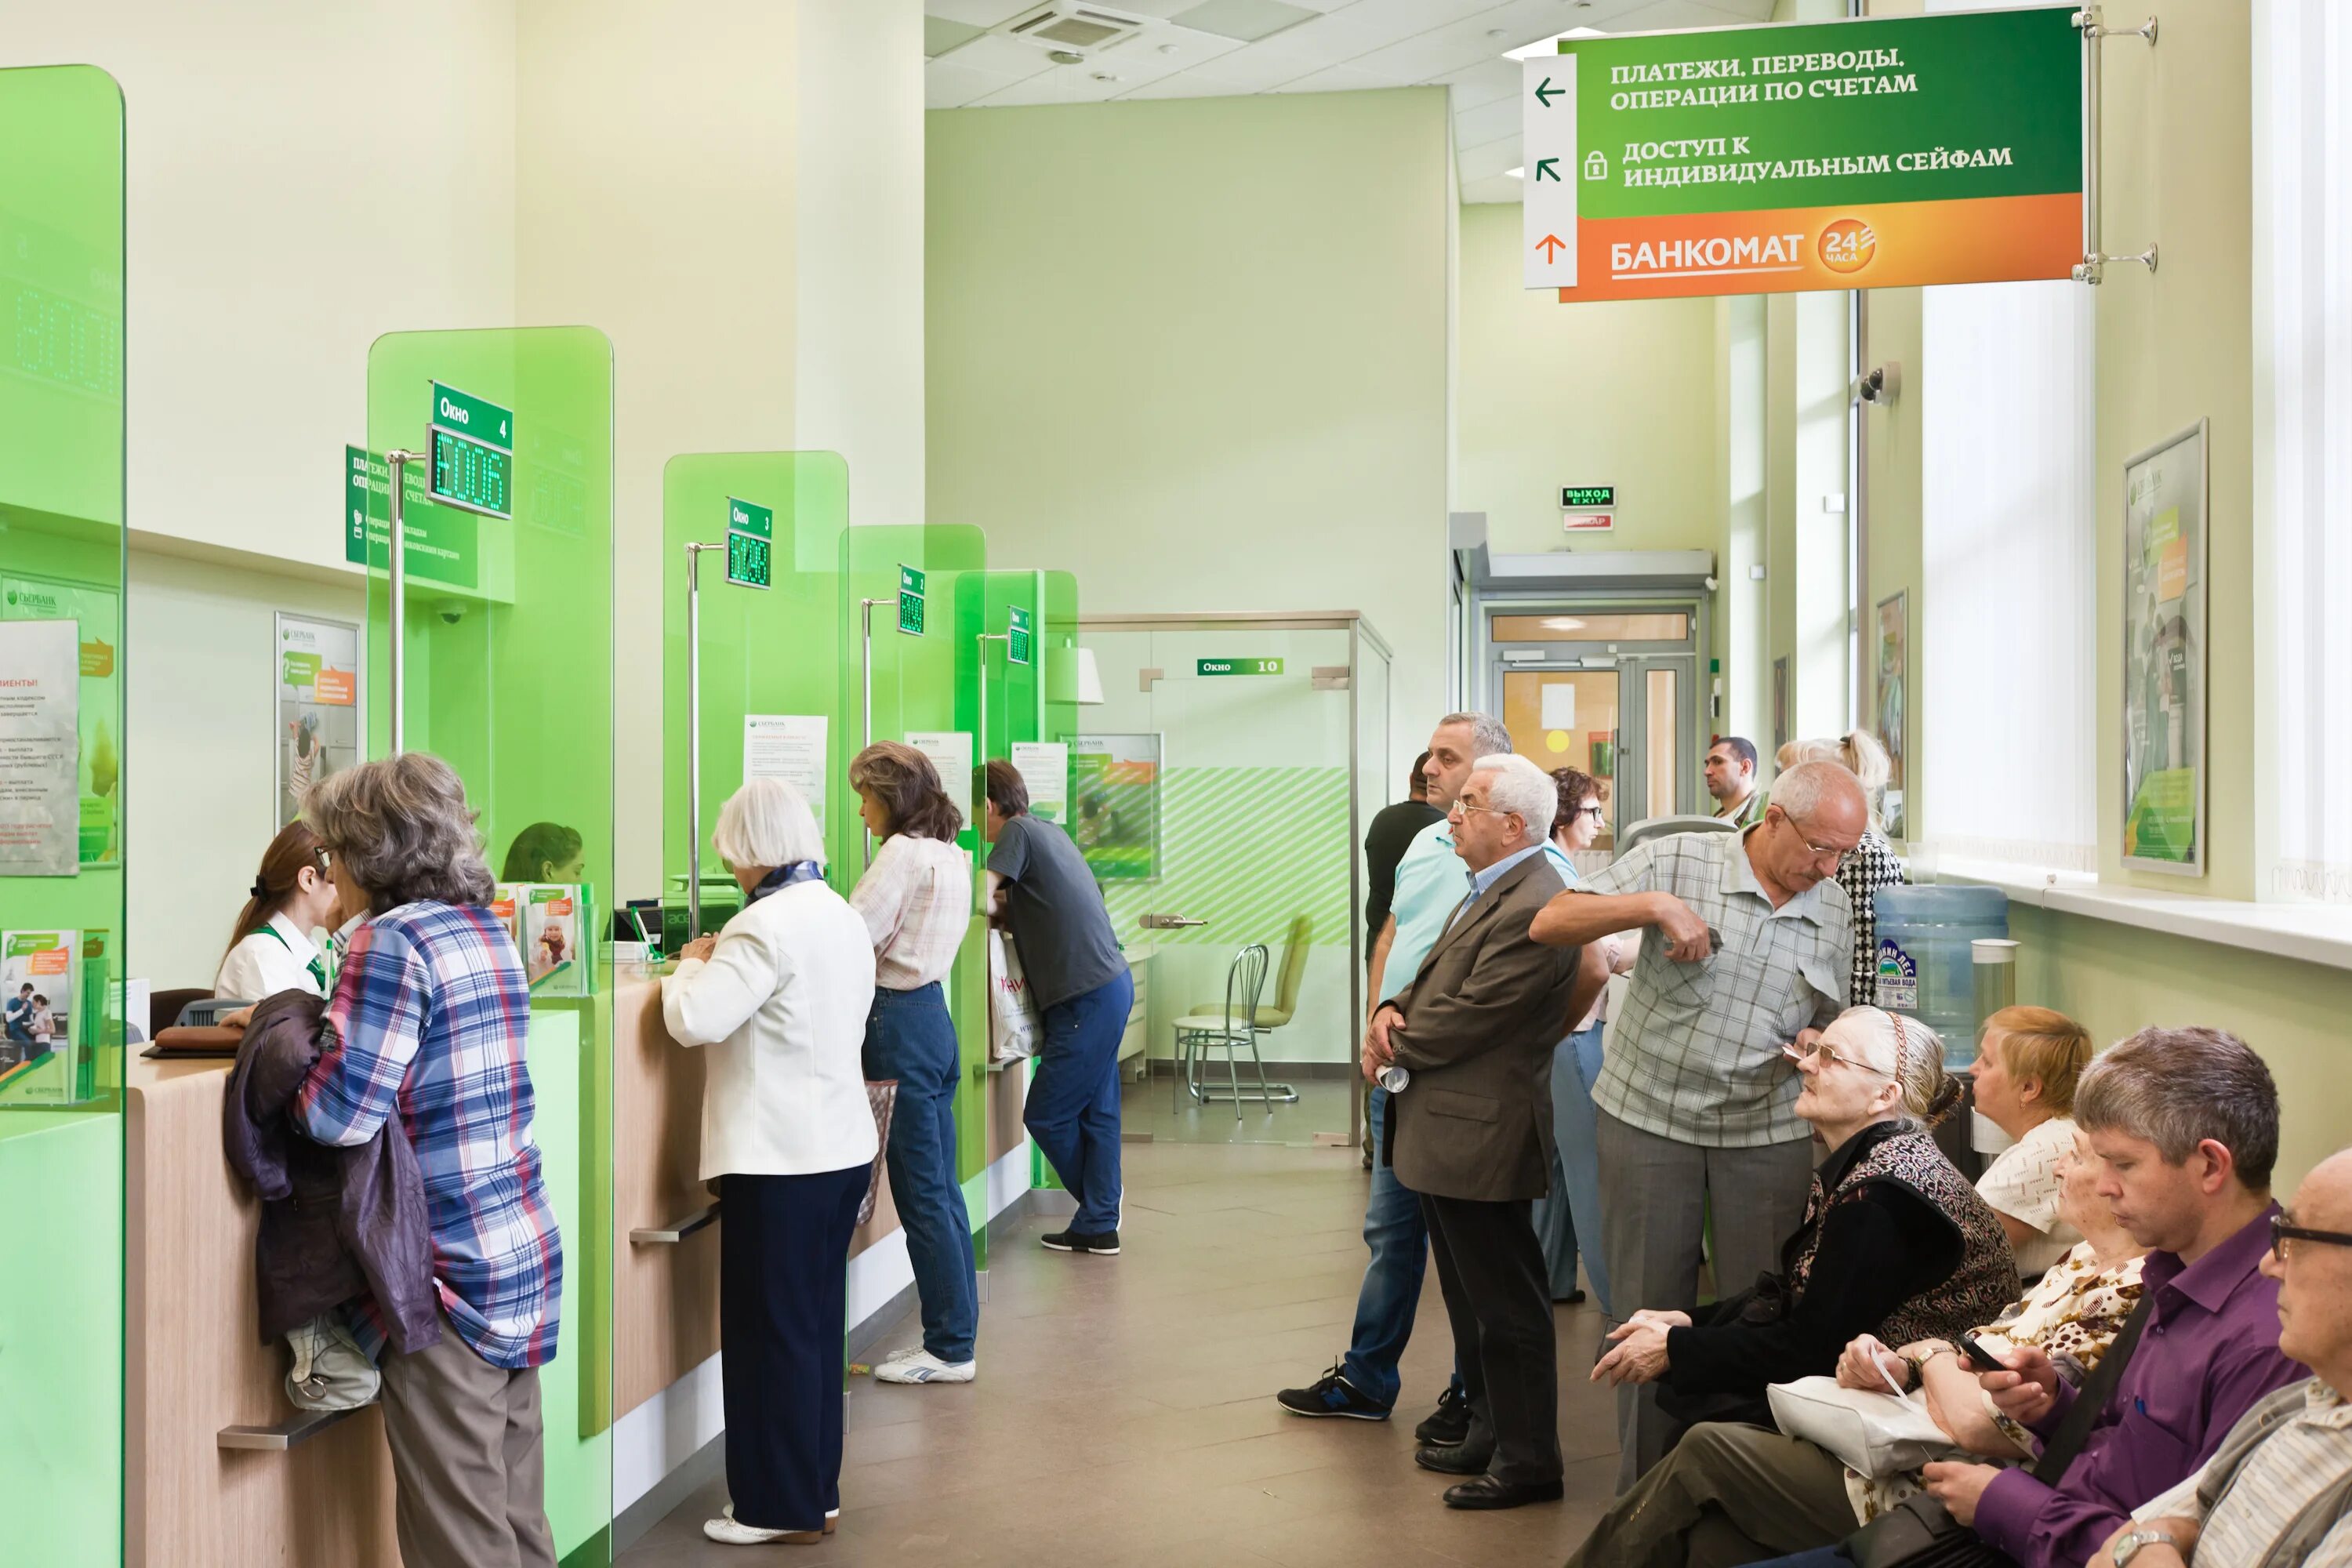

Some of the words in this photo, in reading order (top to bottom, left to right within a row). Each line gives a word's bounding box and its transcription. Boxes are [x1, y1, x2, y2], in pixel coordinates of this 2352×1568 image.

[1610, 59, 1746, 84] ПЛАТЕЖИ.
[1751, 49, 1905, 76] ПЕРЕВОДЫ.
[1610, 83, 1759, 111] ОПЕРАЦИИ
[1764, 81, 1804, 101] ПО
[1808, 74, 1918, 98] СЧЕТАМ
[1622, 136, 1726, 165] ДОСТУП
[1731, 136, 1751, 155] К
[1623, 154, 1892, 189] ИНДИВИДУАЛЬНЫМ
[1896, 147, 2014, 172] СЕЙФАМ
[1825, 231, 1859, 252] 24
[1611, 234, 1805, 271] БАНКОМАТ
[1826, 252, 1859, 263] ЧАСА
[440, 396, 470, 425] Окно
[499, 419, 507, 439] 4
[1566, 489, 1610, 499] ВЫХОД
[733, 506, 750, 525] Окно
[764, 516, 770, 532] 3
[920, 578, 924, 590] 2
[19, 592, 56, 607] СБЕРБАНК
[1203, 662, 1232, 673] Окно
[1258, 661, 1278, 673] 10
[0, 679, 38, 688] ИЕНТЫ!
[668, 913, 690, 924] ace
[1897, 955, 1914, 976] ЛЕС
[1902, 978, 1916, 988] ВОДА
